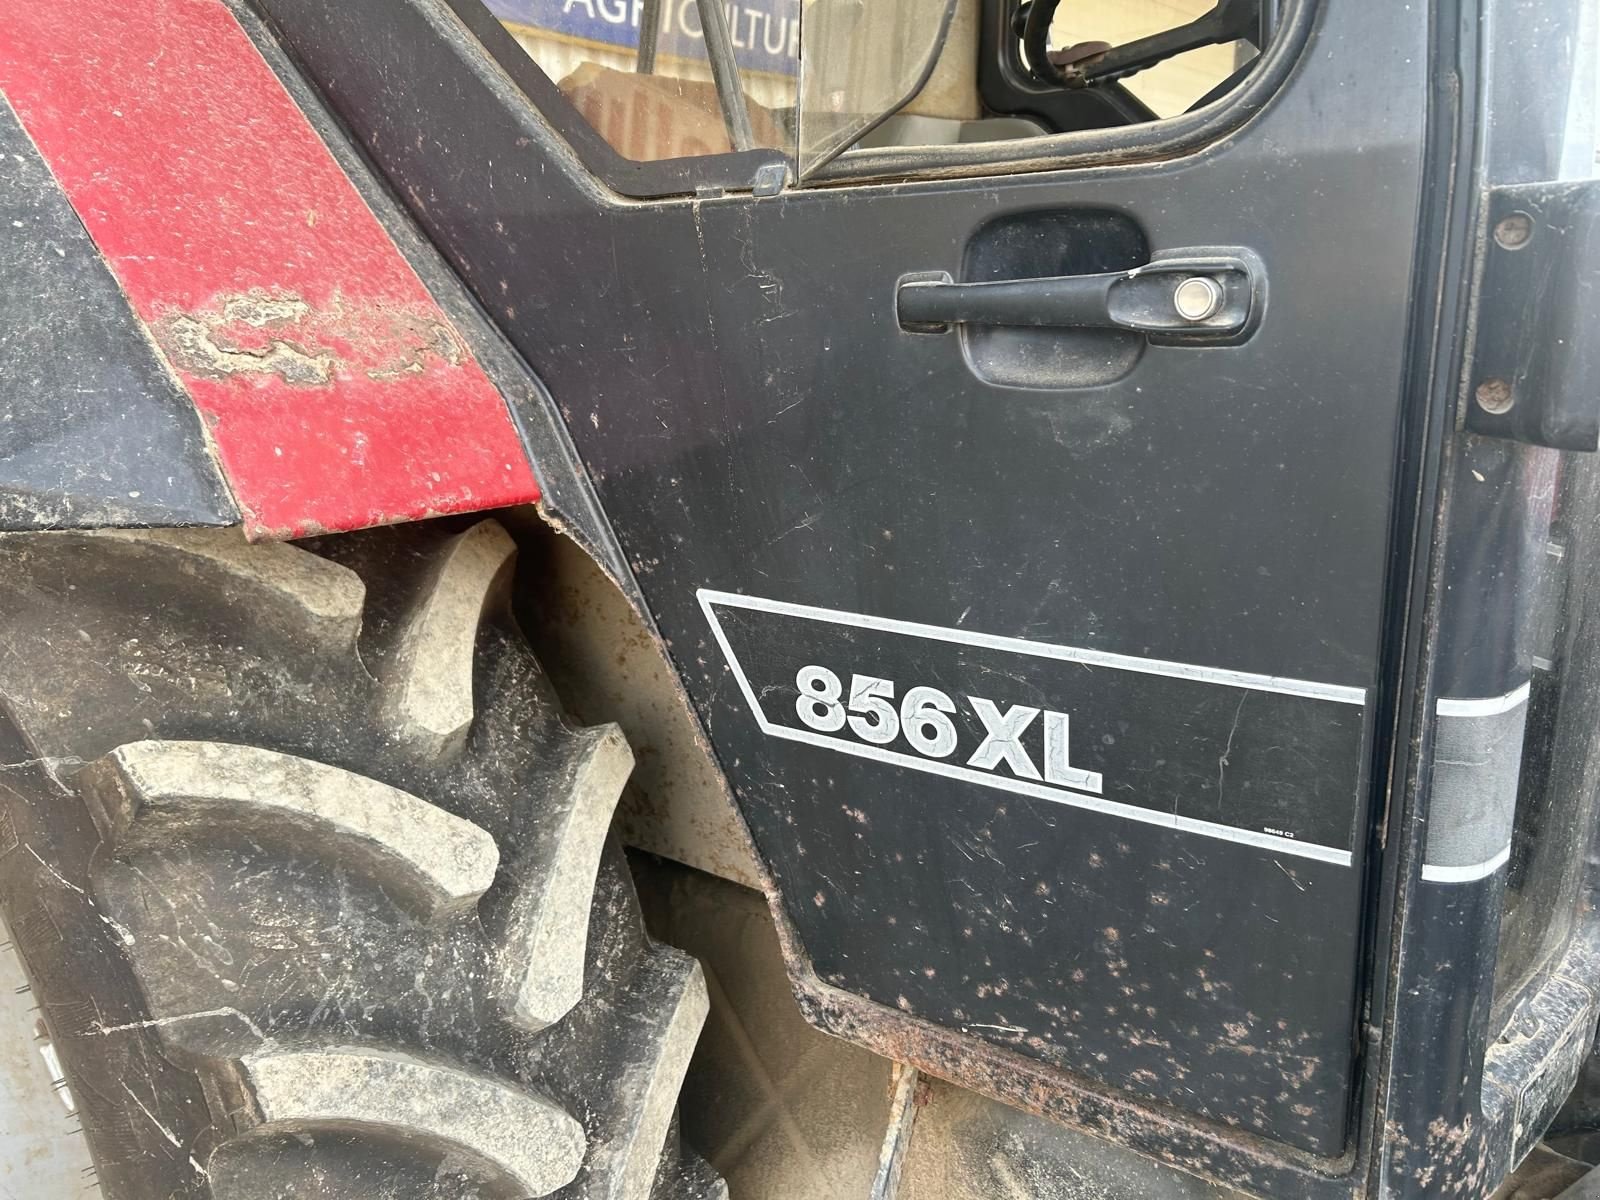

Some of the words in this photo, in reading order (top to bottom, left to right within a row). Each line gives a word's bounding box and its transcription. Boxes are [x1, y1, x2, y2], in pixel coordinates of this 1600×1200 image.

[563, 0, 800, 57] GICLTUR
[796, 665, 958, 758] 856
[966, 696, 1104, 793] XL
